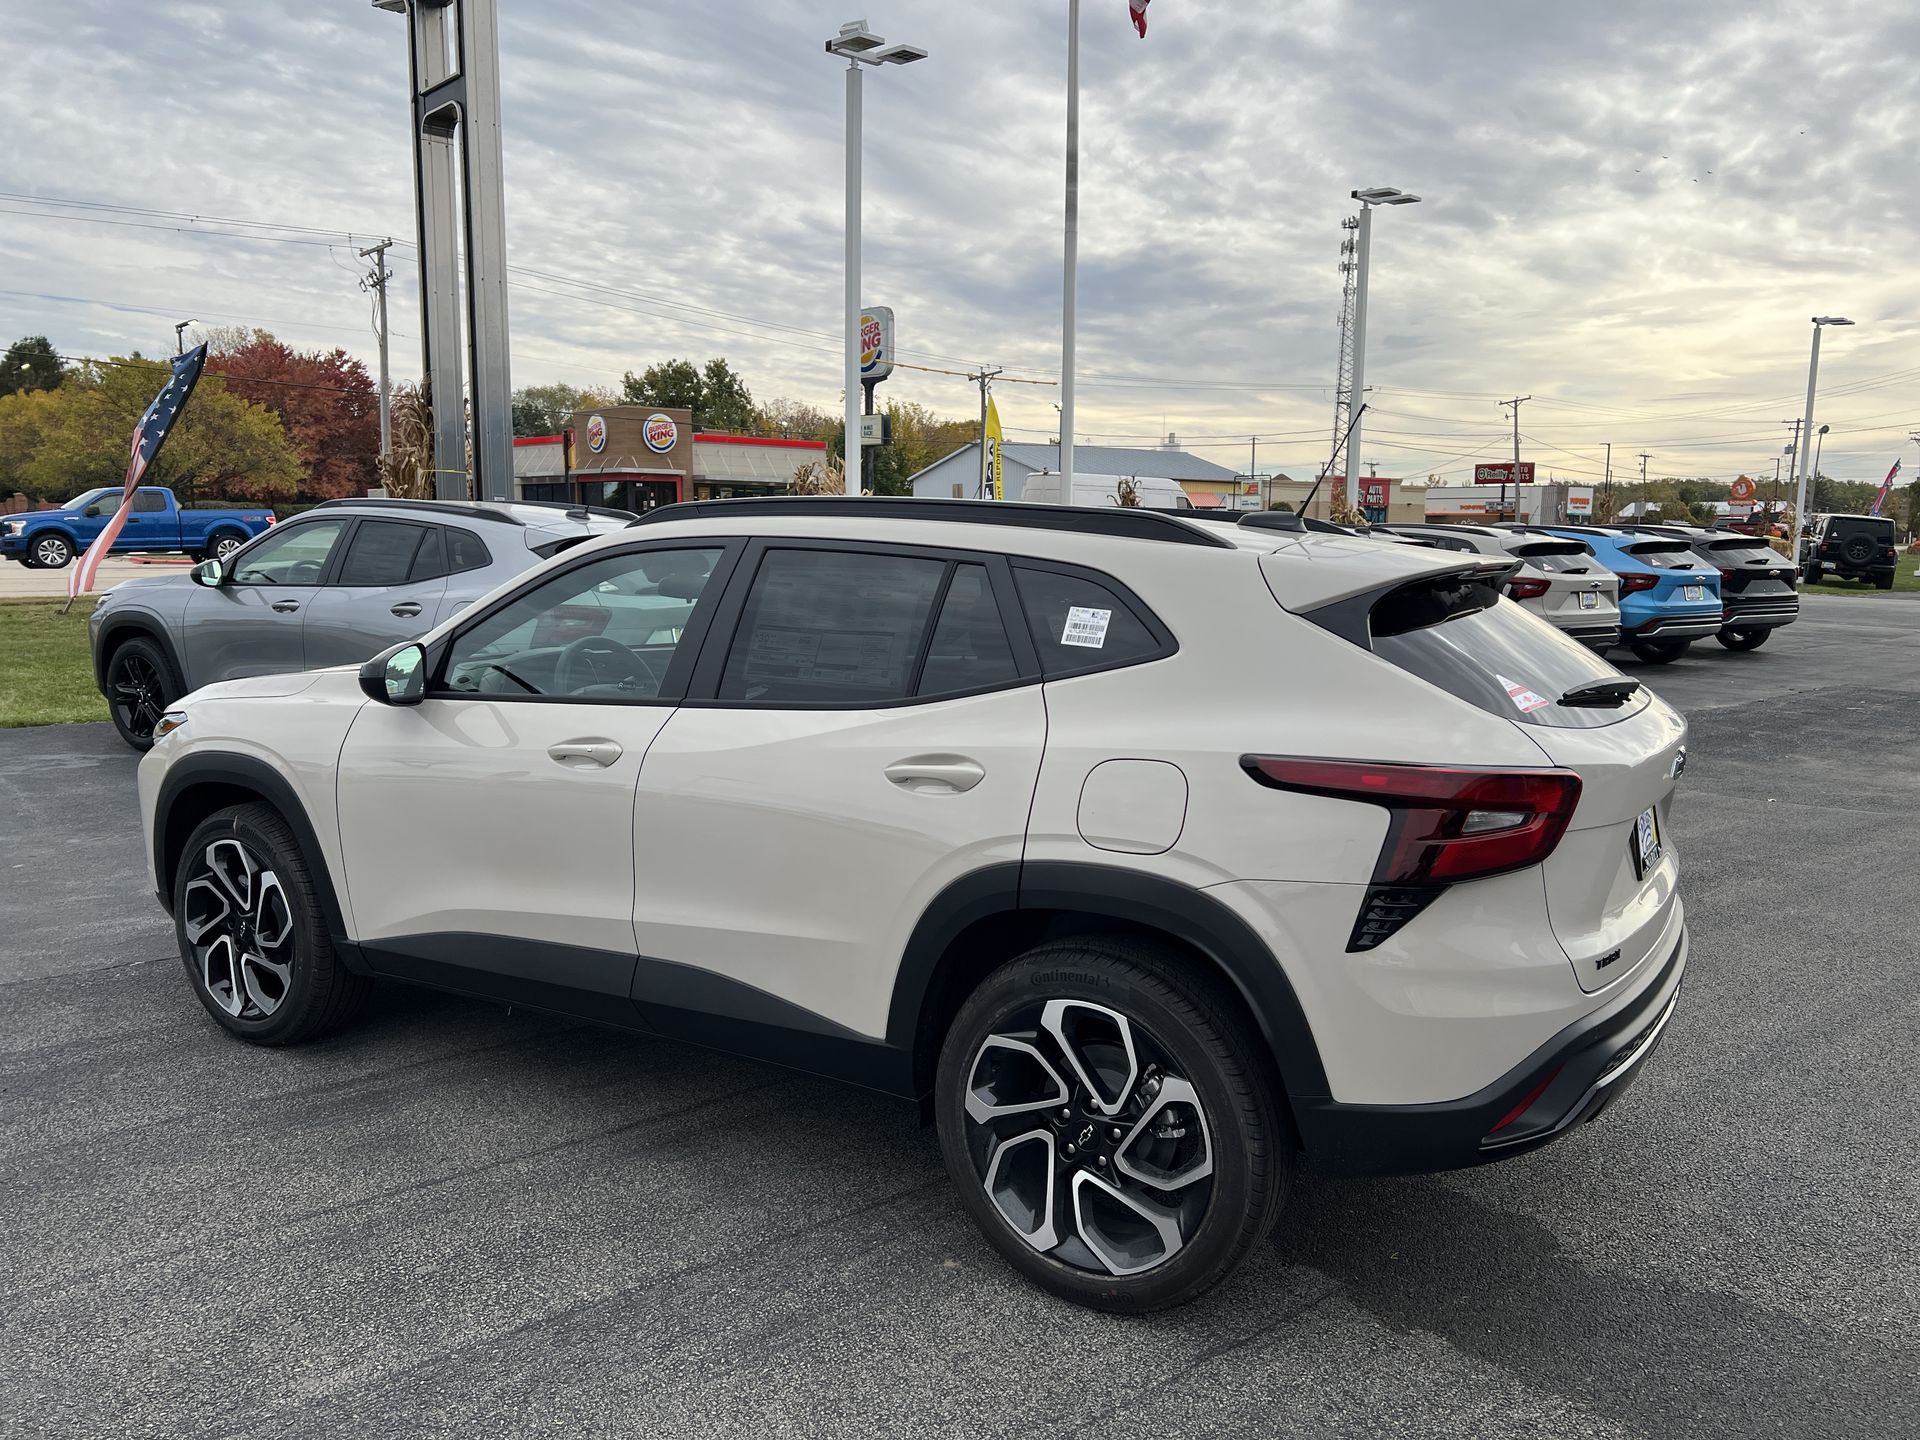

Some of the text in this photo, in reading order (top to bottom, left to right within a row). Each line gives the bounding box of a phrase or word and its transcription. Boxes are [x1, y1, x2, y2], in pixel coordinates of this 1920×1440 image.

[861, 332, 881, 353] NG
[648, 422, 673, 434] BURGER
[650, 429, 674, 442] KING
[1478, 467, 1507, 480] O'Reilly
[1368, 485, 1383, 495] AUTO
[1366, 494, 1383, 504] PARTS
[1030, 968, 1101, 987] Continental
